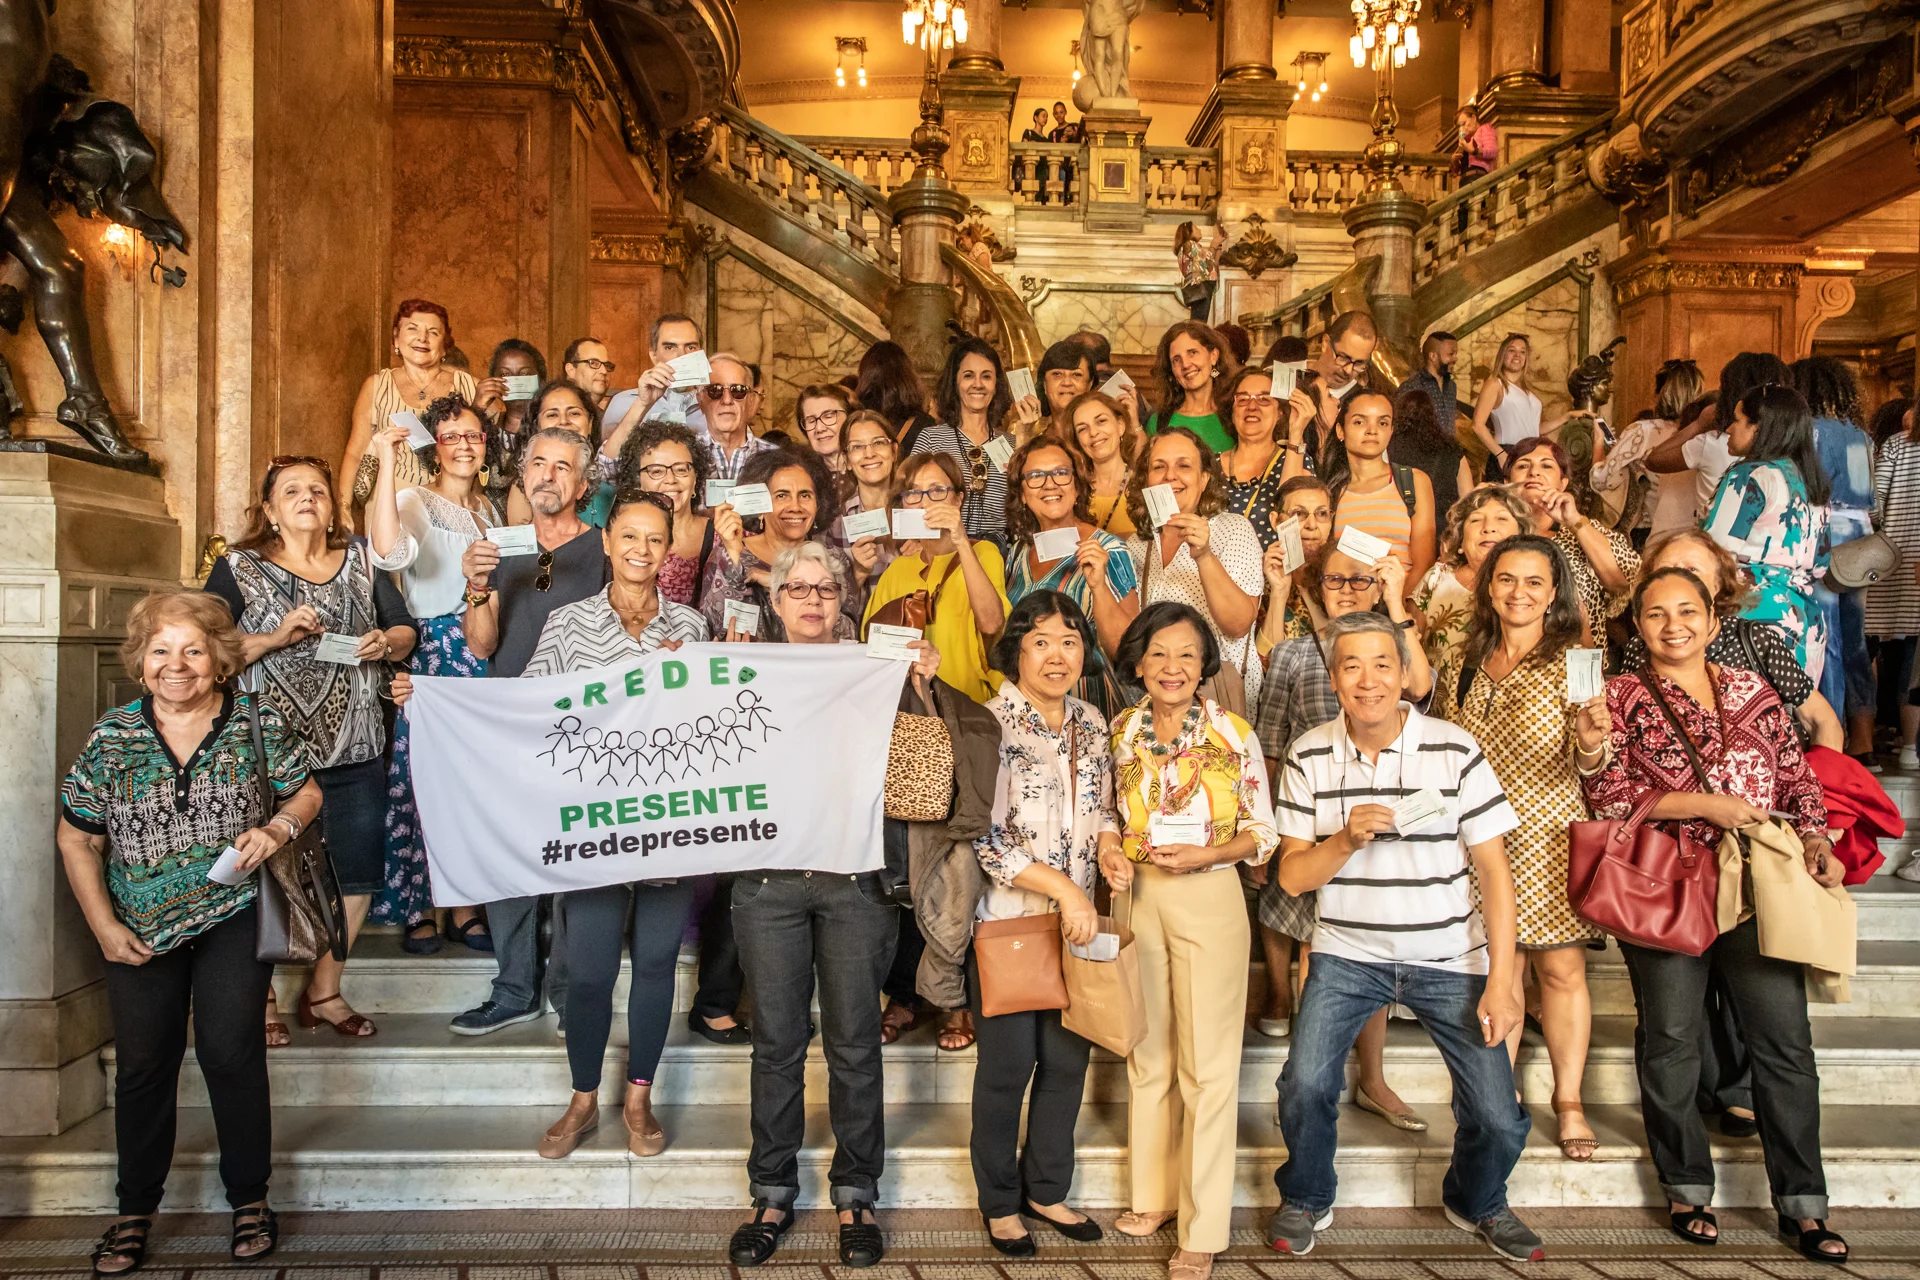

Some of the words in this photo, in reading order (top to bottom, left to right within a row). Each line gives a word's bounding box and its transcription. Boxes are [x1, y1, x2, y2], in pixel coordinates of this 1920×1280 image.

[582, 657, 730, 707] REDE
[560, 783, 769, 832] PRESENTE
[542, 818, 778, 865] #redepresente
